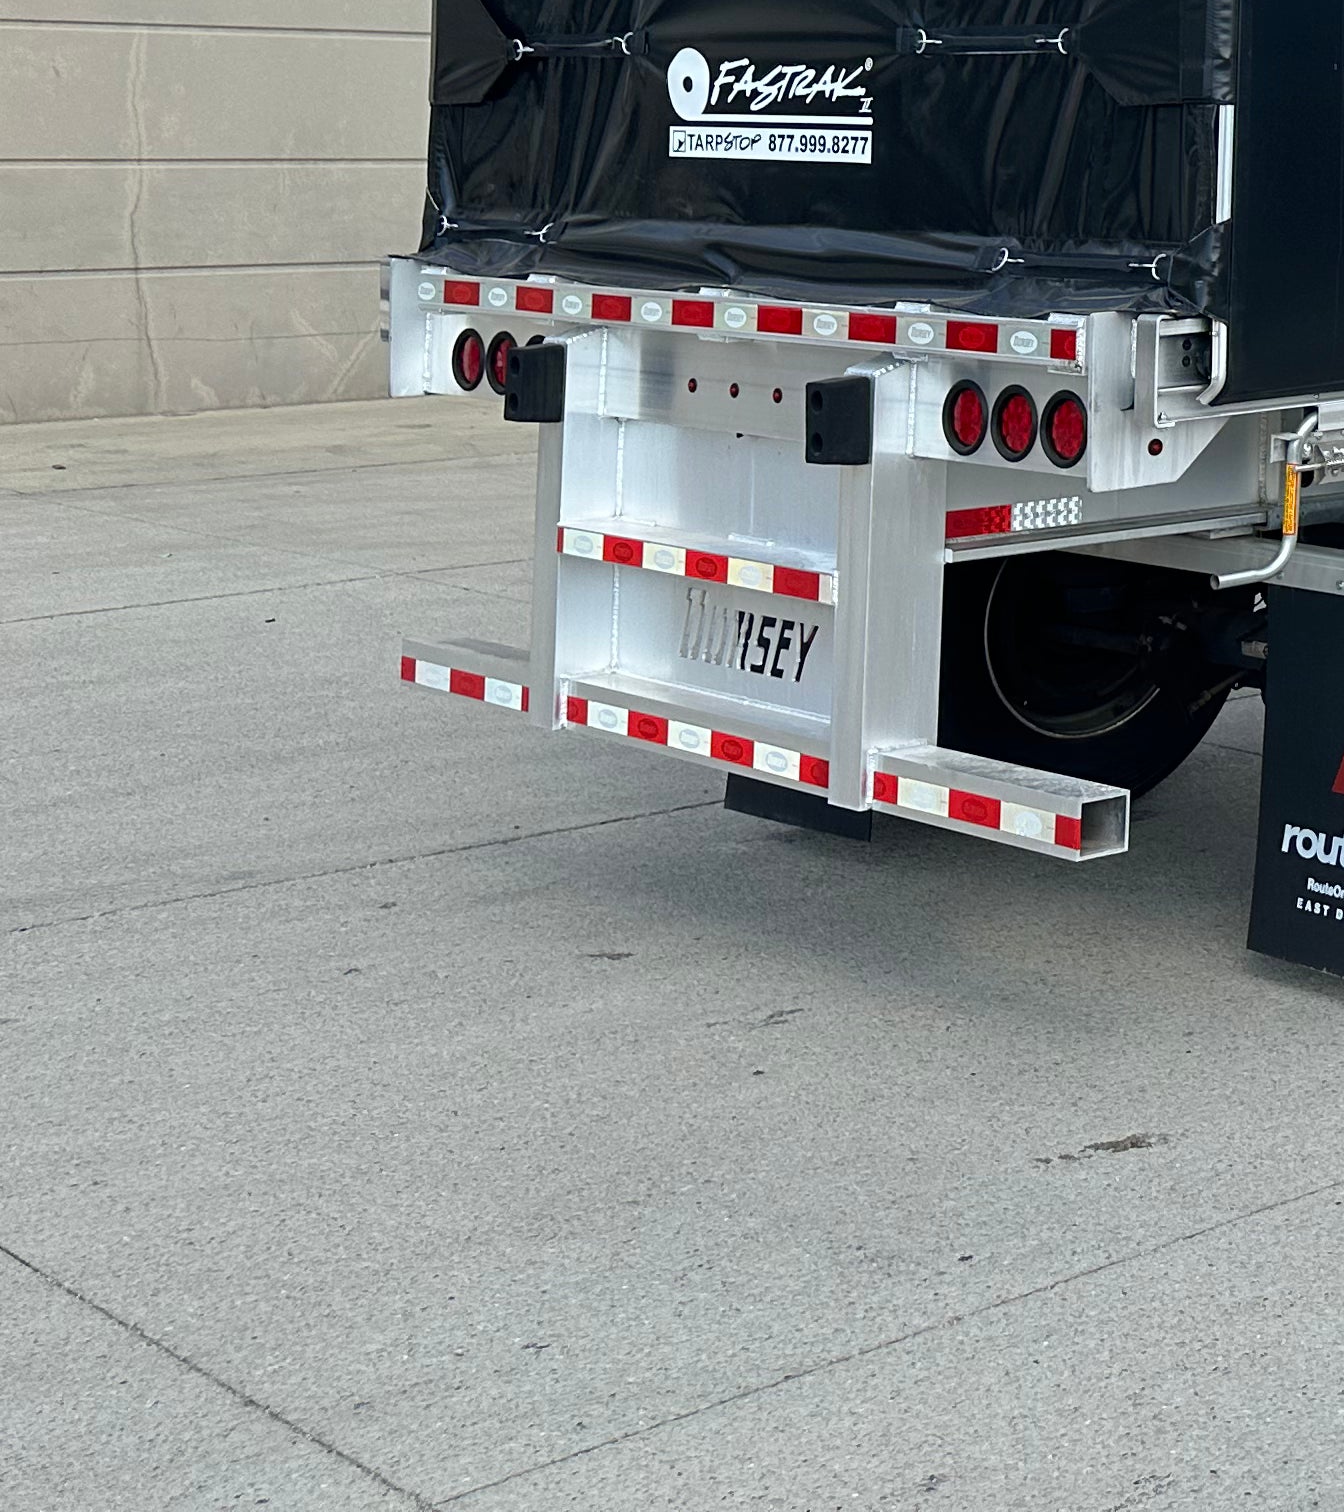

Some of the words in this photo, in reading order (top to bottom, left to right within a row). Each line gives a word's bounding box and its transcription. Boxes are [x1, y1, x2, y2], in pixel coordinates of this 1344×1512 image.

[710, 57, 866, 112] FASTRAK
[686, 131, 762, 152] TARPSTOP
[768, 133, 870, 155] 877.999.8277
[1296, 896, 1330, 917] EAST
